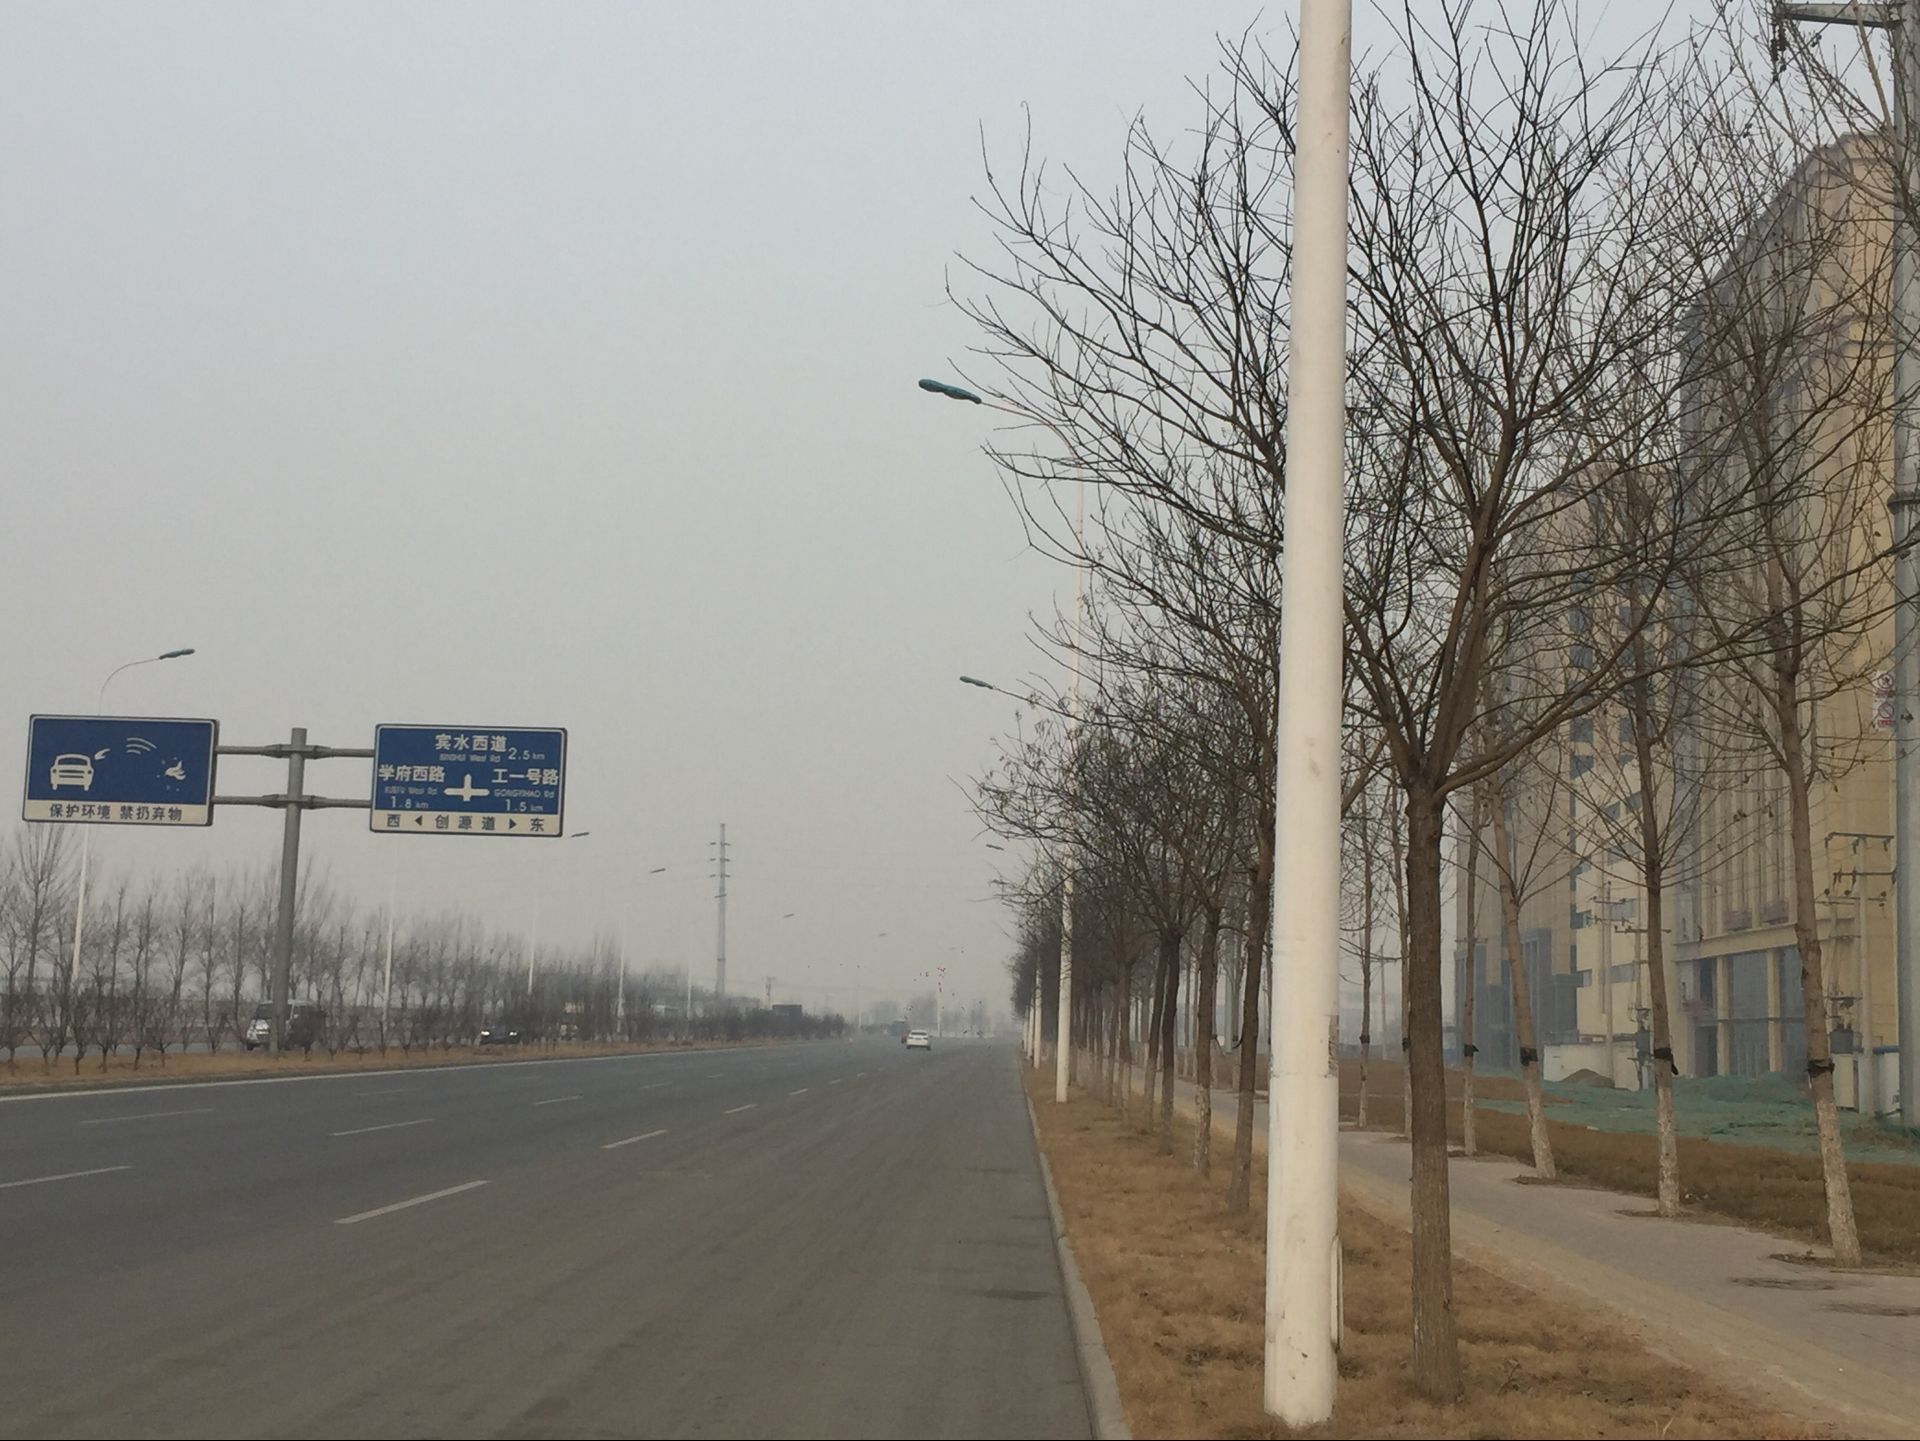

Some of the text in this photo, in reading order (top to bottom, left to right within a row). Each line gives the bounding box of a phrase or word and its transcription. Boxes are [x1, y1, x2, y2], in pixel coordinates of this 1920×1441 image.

[435, 734, 508, 753] 宾水西道
[508, 747, 530, 761] 2.5
[378, 764, 446, 783] 学府西路
[491, 768, 559, 786] 工一号路
[390, 796, 412, 809] 1.8
[505, 799, 527, 812] 1.5
[49, 803, 183, 821] 保护环境 禁扔弃物
[387, 814, 545, 831] 西 创源道 东
